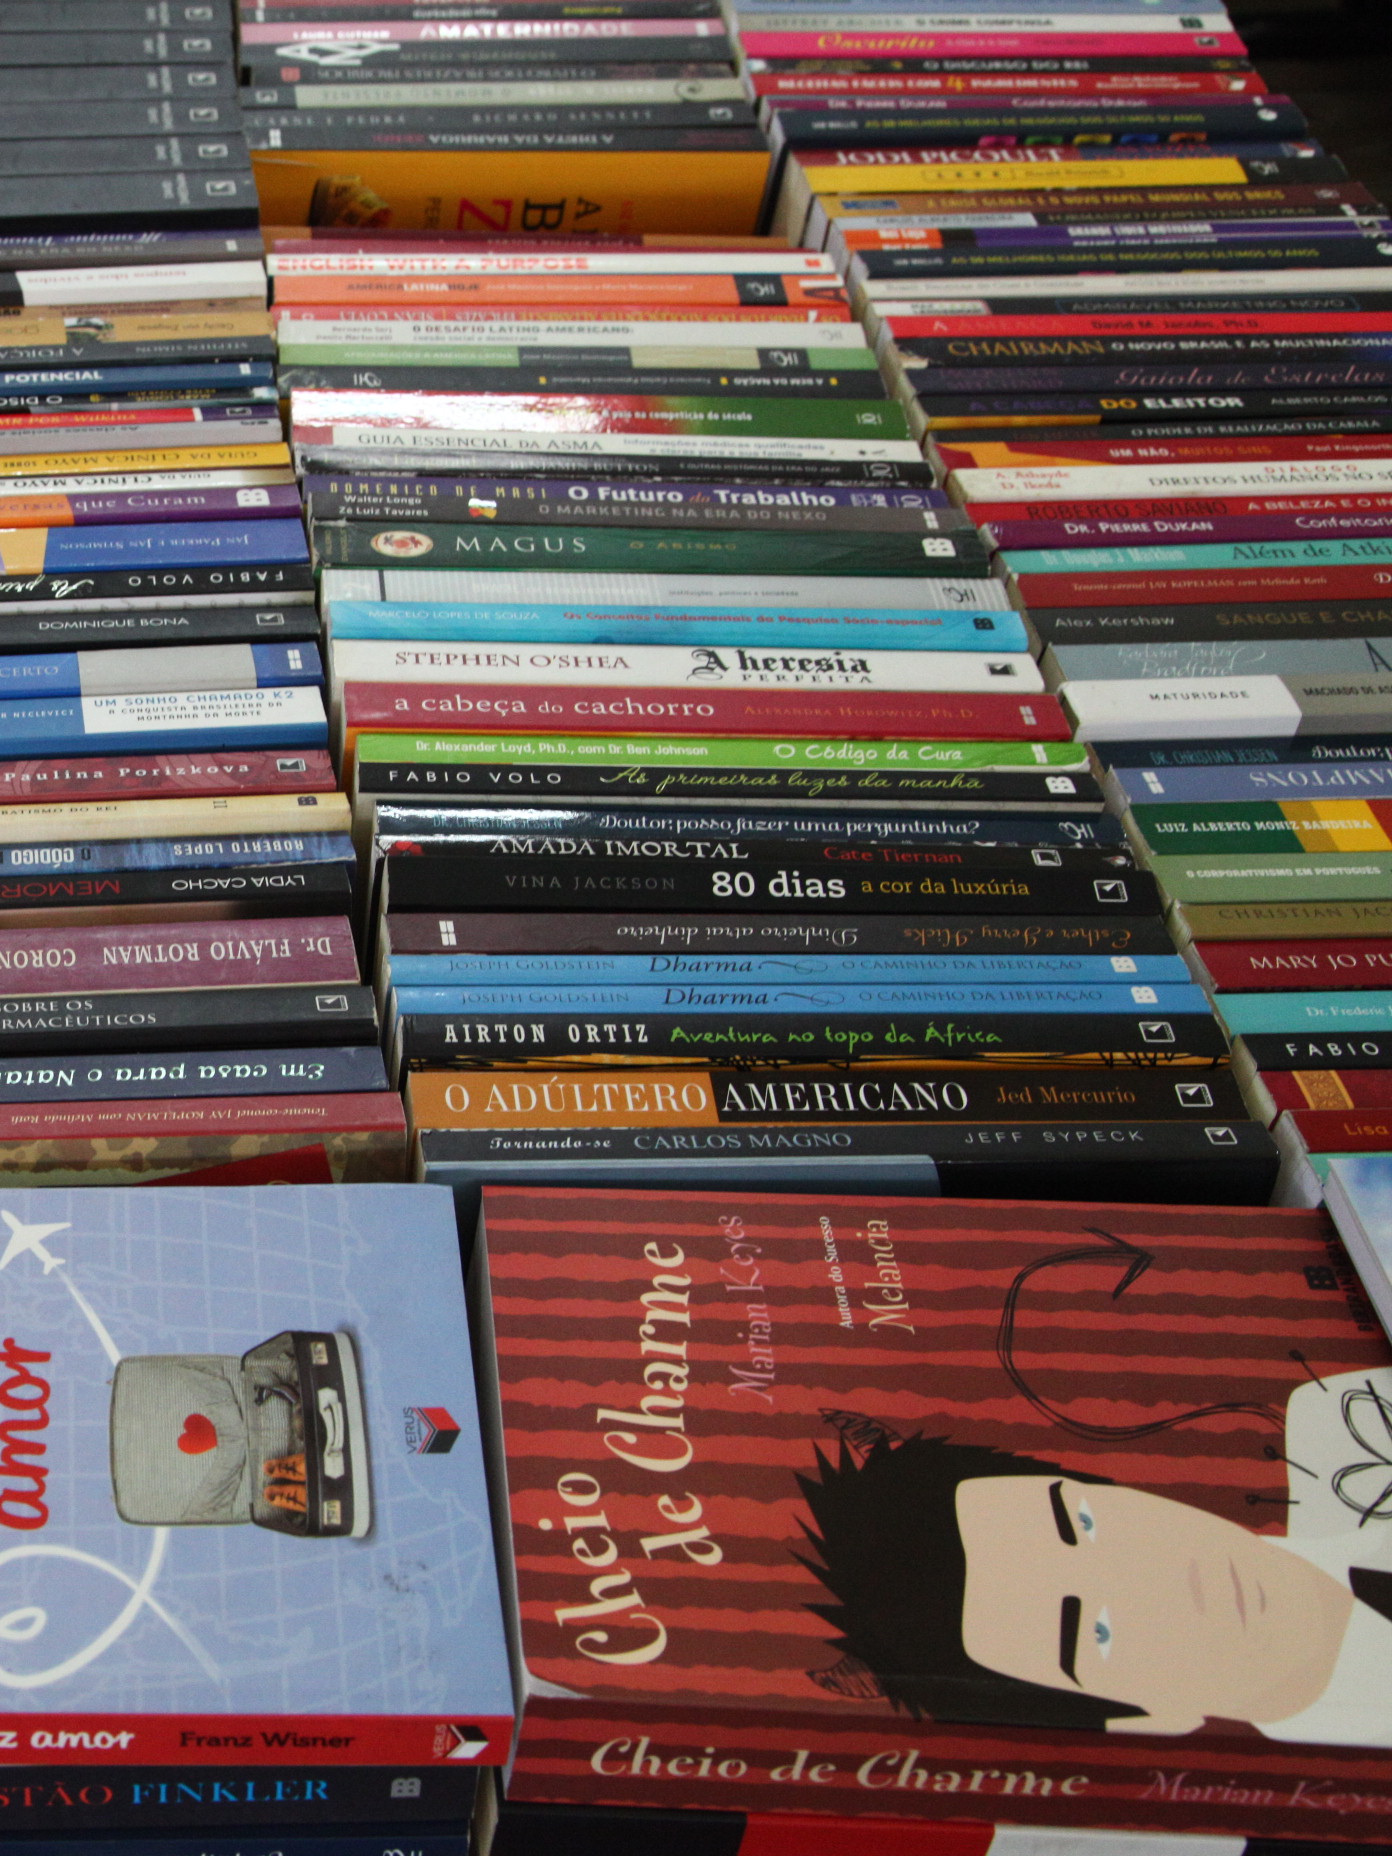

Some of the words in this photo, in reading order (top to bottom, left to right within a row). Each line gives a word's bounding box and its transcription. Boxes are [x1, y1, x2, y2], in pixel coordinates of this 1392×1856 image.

[836, 150, 911, 165] JODI
[920, 149, 1063, 163] PICOULT
[277, 257, 374, 271] ENGLISH
[388, 257, 446, 270] WITH
[454, 258, 471, 270] A
[481, 257, 590, 270] PURPOSE
[947, 340, 1105, 356] CHAIRMAN
[4, 370, 103, 384] POTENCIAL
[1099, 398, 1137, 409] DO
[1142, 396, 1244, 409] ELEITOR
[567, 485, 589, 500] O
[597, 486, 683, 503] Futuro
[713, 489, 836, 507] Trabalho
[1063, 522, 1095, 534] DR.
[1098, 521, 1151, 533] PIERRE
[1153, 520, 1214, 532] DUKAN
[456, 536, 586, 553] MAGUS
[128, 573, 193, 587] VOLO
[209, 570, 284, 583] FABIO
[38, 618, 135, 630] DOMINIQUE
[139, 617, 189, 627] BONA
[1055, 617, 1093, 627] Alex
[1098, 615, 1174, 626] Kershaw
[395, 651, 520, 667] STEPHEN
[529, 655, 629, 669] O'SHEA
[1148, 690, 1249, 701] MATURIDADE
[394, 698, 410, 711] a
[421, 693, 527, 717] cabeça
[538, 700, 563, 713] do
[573, 696, 714, 716] cachorro
[4, 769, 103, 782] Paulina
[118, 764, 248, 777] Porizkova
[1154, 822, 1188, 833] LUIZ
[1192, 821, 1251, 832] ALBERTO
[1254, 820, 1299, 831] MONIZ
[1302, 820, 1374, 830] BANDEIRA
[488, 838, 595, 857] AMADA
[604, 839, 749, 859] IMORTAL
[711, 870, 755, 897] 80
[768, 870, 846, 898] dias
[860, 880, 873, 893] a
[879, 880, 913, 893] cor
[919, 877, 946, 894] da
[950, 877, 1030, 895] luxúria
[1249, 955, 1317, 969] MARY
[1327, 954, 1357, 970] JO
[444, 1023, 545, 1043] AIRTON
[567, 1023, 648, 1043] ORTIZ
[444, 1084, 469, 1112] O
[484, 1075, 707, 1112] ADÚLTERO
[722, 1082, 968, 1111] AMERICANO
[996, 1086, 1032, 1103] Jed
[1039, 1086, 1136, 1104] Mercurio
[633, 1134, 741, 1149] CARLOS
[747, 1132, 852, 1148] MAGNO
[718, 1215, 765, 1292] Keyes
[856, 1219, 915, 1335] Melancia
[596, 1239, 695, 1473] Charme
[728, 1302, 775, 1405] Marian
[640, 1491, 724, 1567] de
[538, 1470, 667, 1667] Cheio
[30, 1730, 135, 1749] amor
[179, 1731, 253, 1748] Franz
[260, 1731, 355, 1749] Wisner
[590, 1735, 747, 1778] Cheio
[769, 1749, 836, 1783] de
[856, 1749, 1088, 1796] Charme
[131, 1780, 329, 1804] FINKLER
